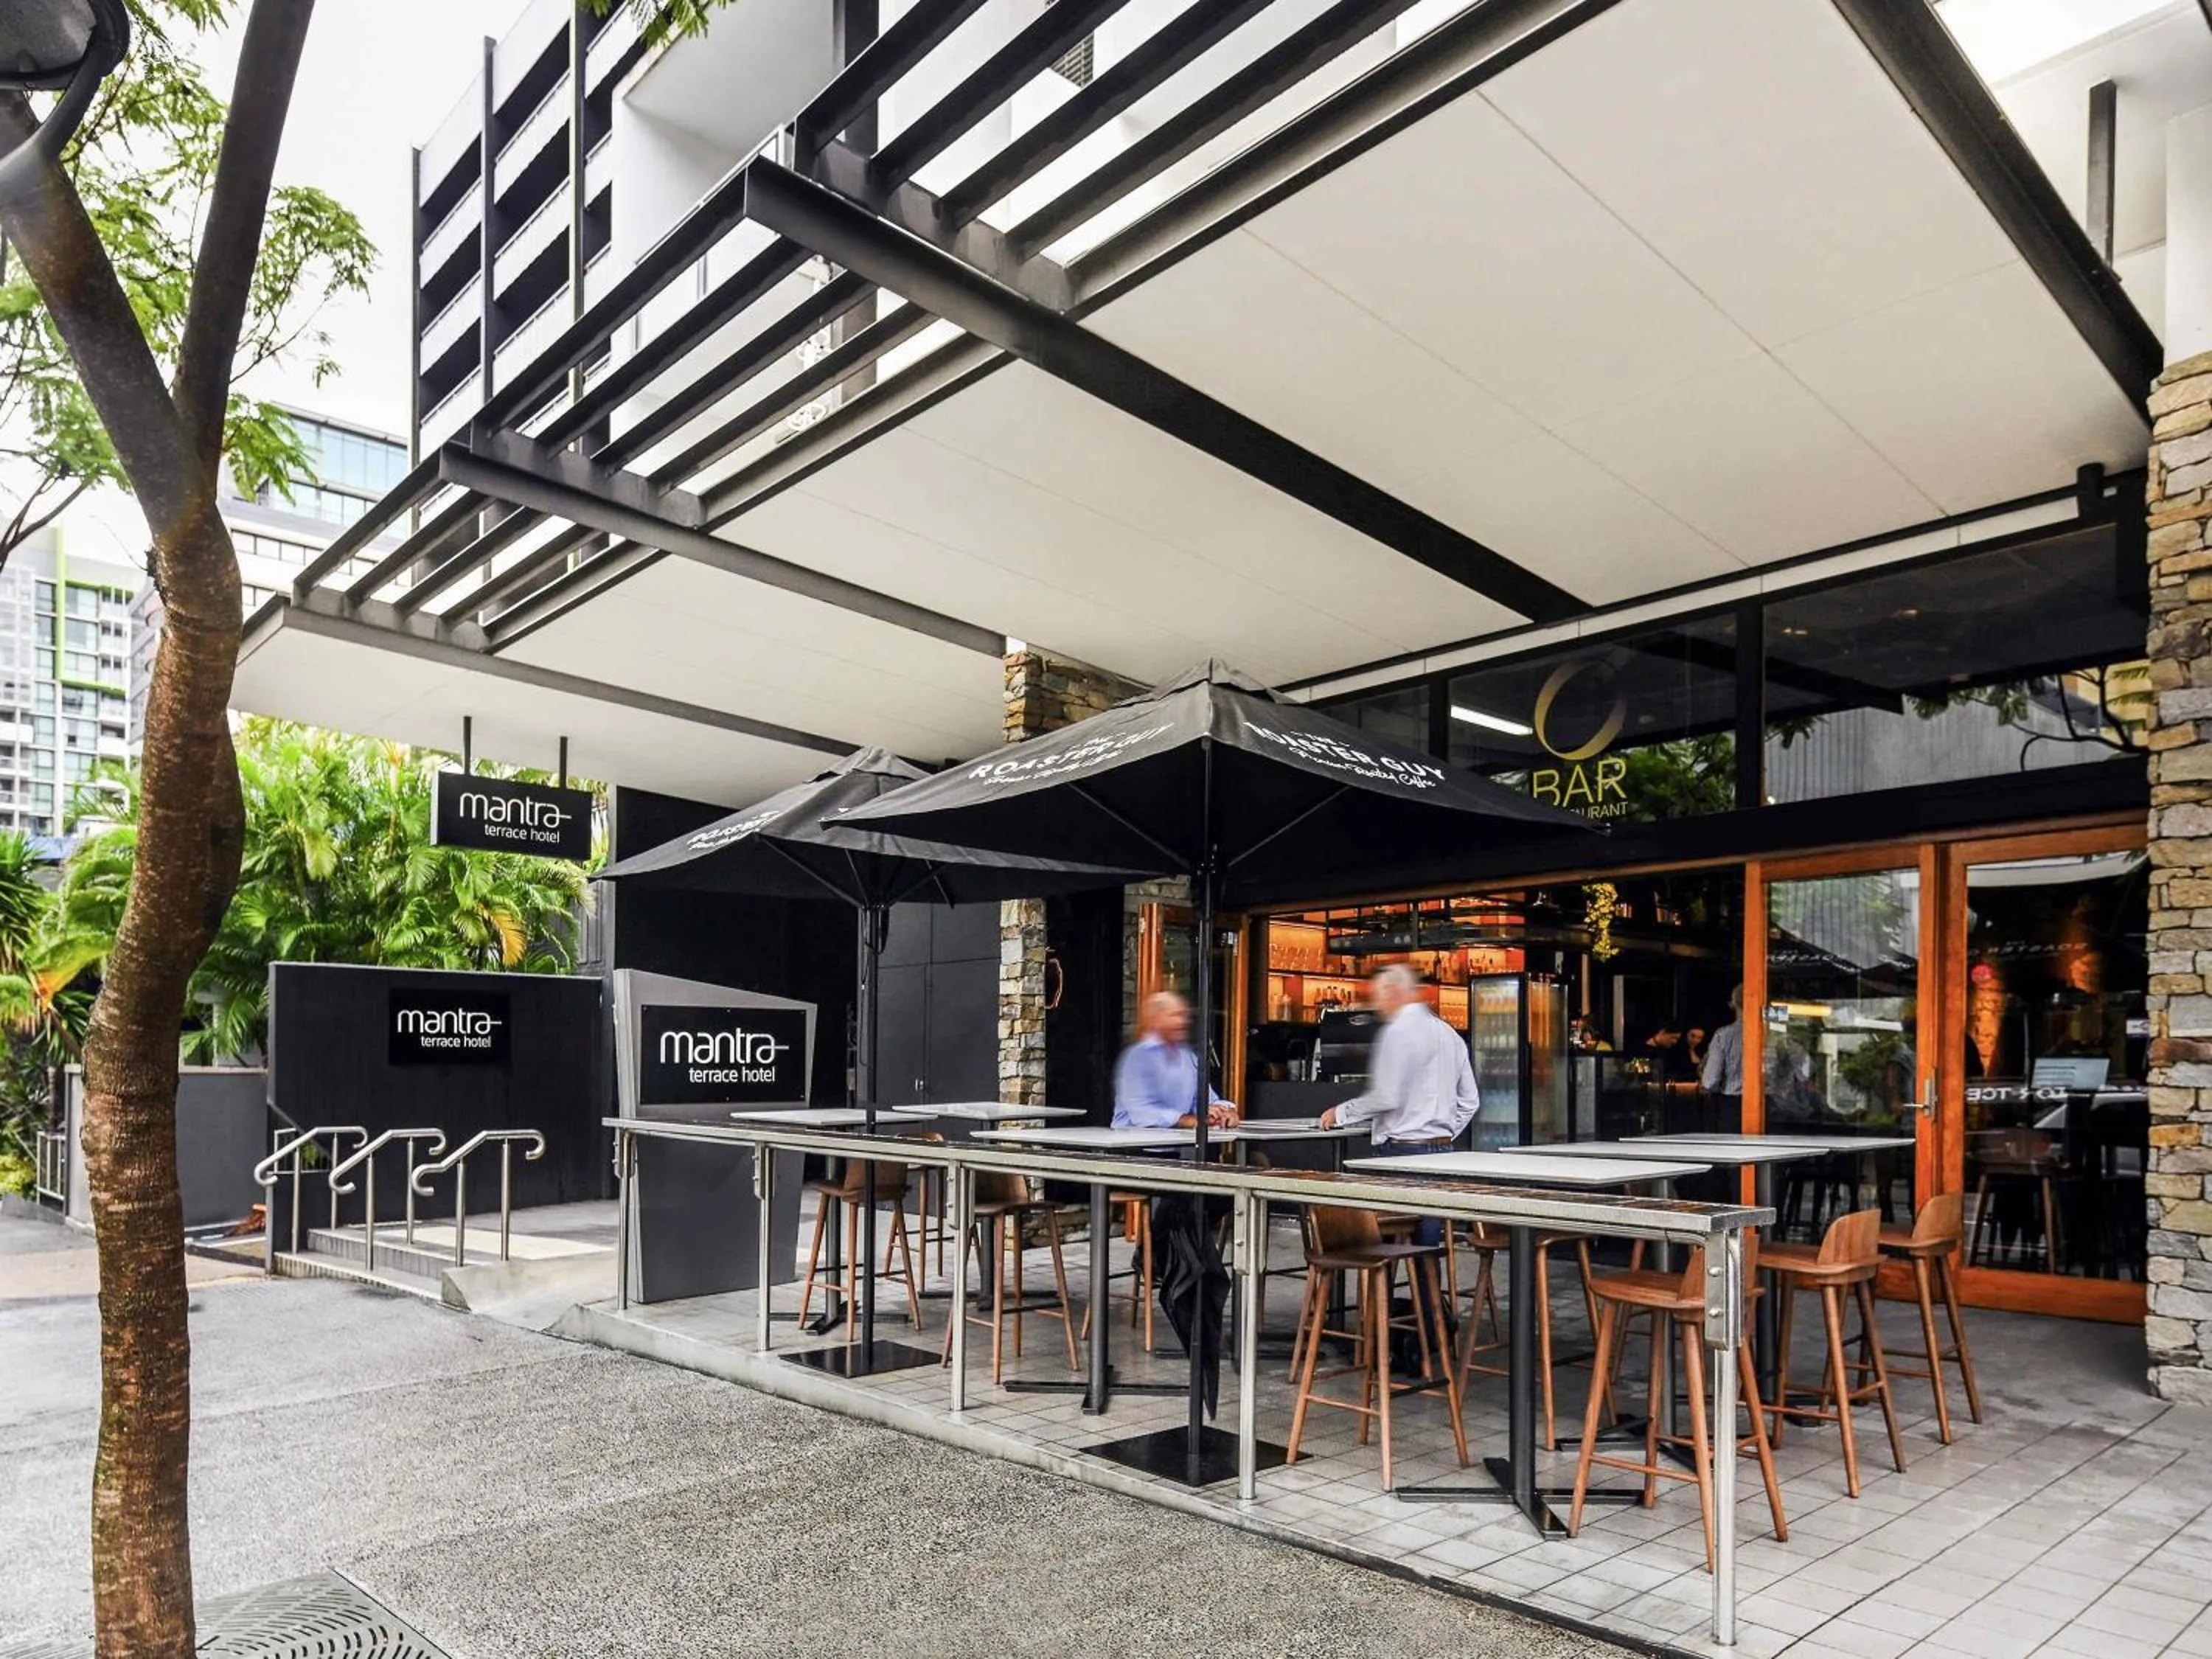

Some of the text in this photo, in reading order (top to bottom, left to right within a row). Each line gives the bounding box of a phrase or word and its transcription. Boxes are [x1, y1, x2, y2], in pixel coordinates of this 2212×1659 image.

[1380, 757, 1445, 780] GUY
[1533, 758, 1627, 807] BAR
[459, 793, 572, 828] mantra
[484, 824, 560, 843] terrace hotel
[397, 1007, 502, 1034] mantra
[421, 1034, 492, 1048] terrace hotel
[660, 1027, 790, 1064] mantra
[689, 1065, 775, 1083] terrace hotel
